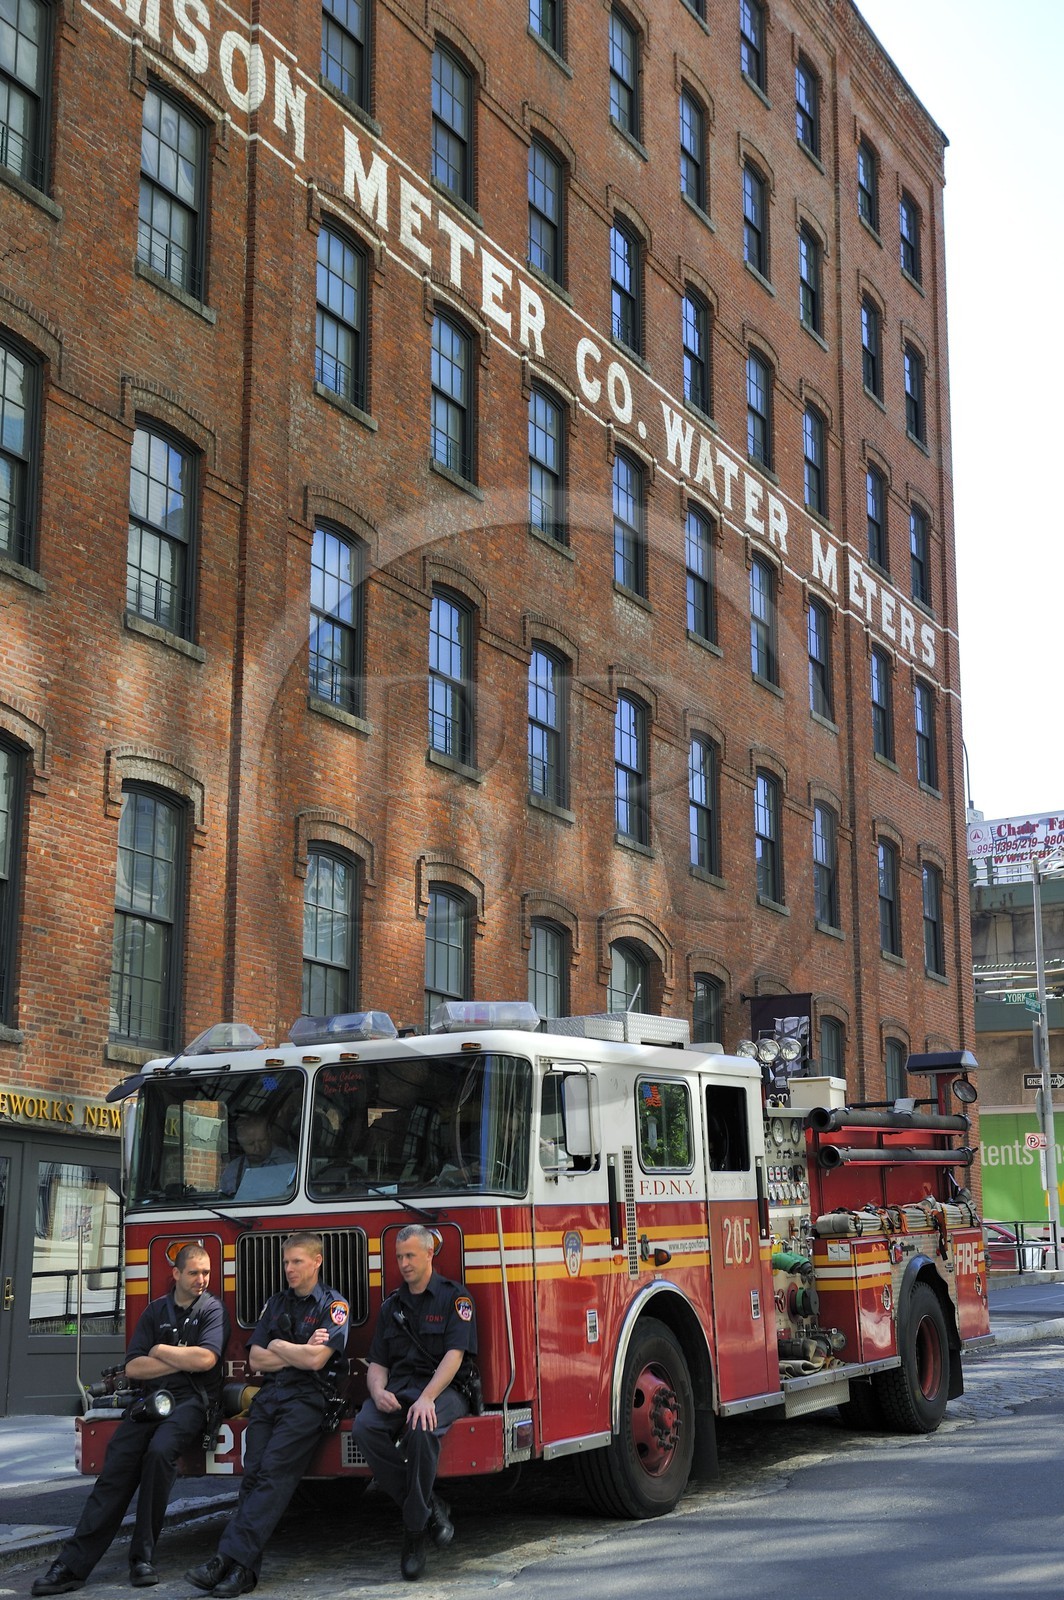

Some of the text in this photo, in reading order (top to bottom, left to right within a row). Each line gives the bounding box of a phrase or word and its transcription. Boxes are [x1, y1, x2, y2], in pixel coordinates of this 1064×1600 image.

[342, 125, 547, 358] METER
[575, 337, 647, 440] CO.
[659, 400, 789, 555] WATER
[810, 528, 936, 668] METERS
[997, 821, 1039, 838] Chair
[1007, 993, 1026, 1003] YORK
[639, 1179, 698, 1195] F.D.N.Y.
[723, 1218, 753, 1264] 205
[956, 1242, 978, 1275] FIRE
